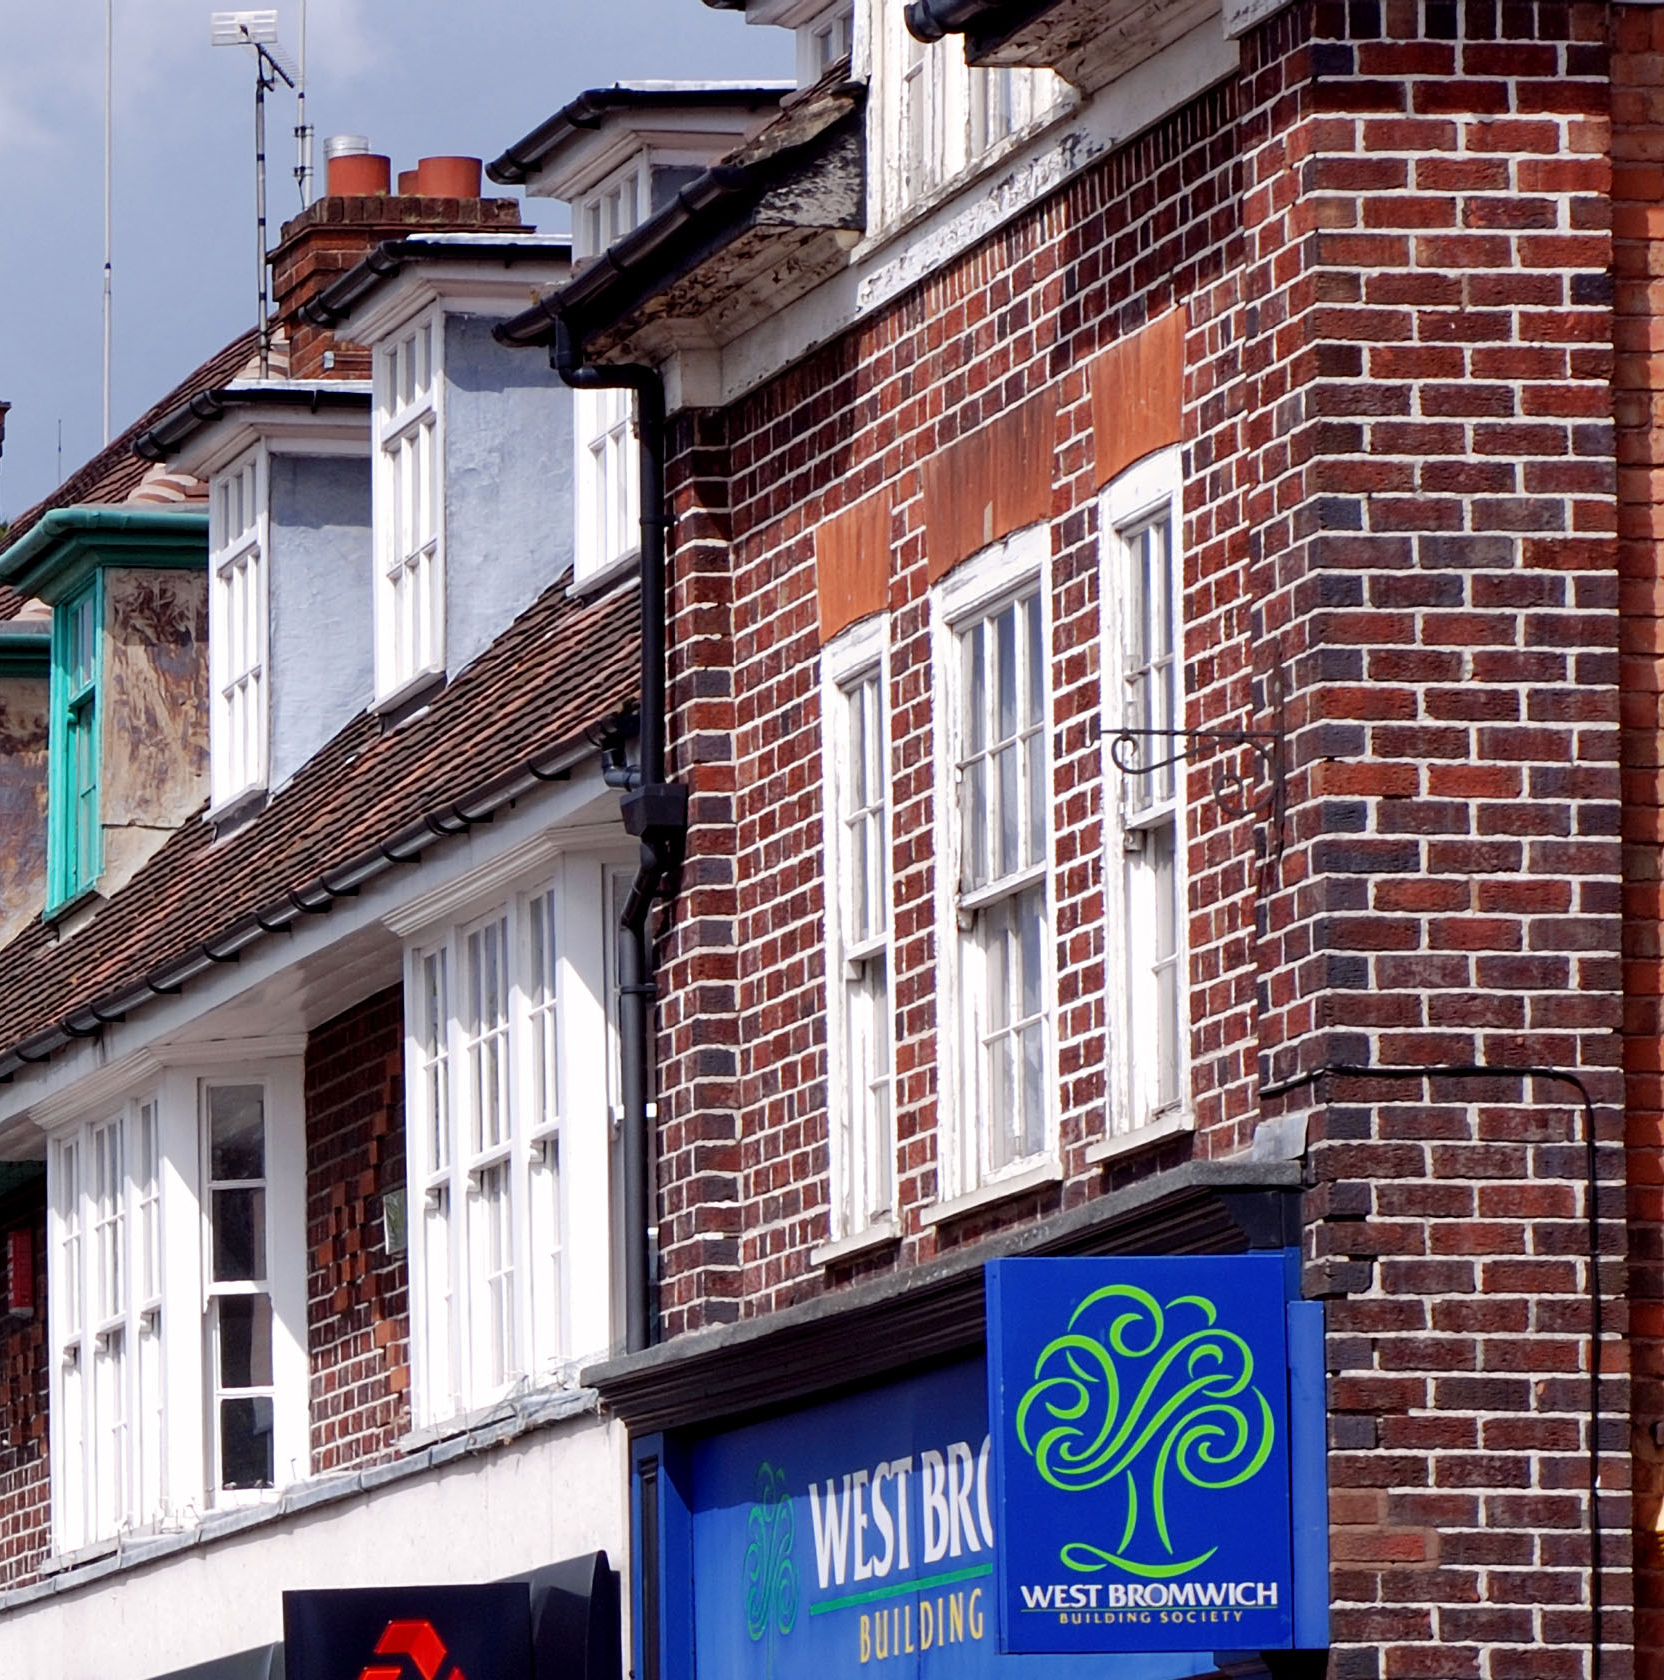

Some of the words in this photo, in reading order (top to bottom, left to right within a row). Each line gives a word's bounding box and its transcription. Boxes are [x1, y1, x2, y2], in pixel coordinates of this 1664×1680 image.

[808, 1456, 913, 1589] WEST
[1021, 1584, 1102, 1608] WEST
[1108, 1582, 1278, 1608] BROMWICH
[1059, 1612, 1151, 1625] BUILDING
[1160, 1611, 1243, 1624] SOCIETY
[859, 1588, 984, 1664] BUILDING
